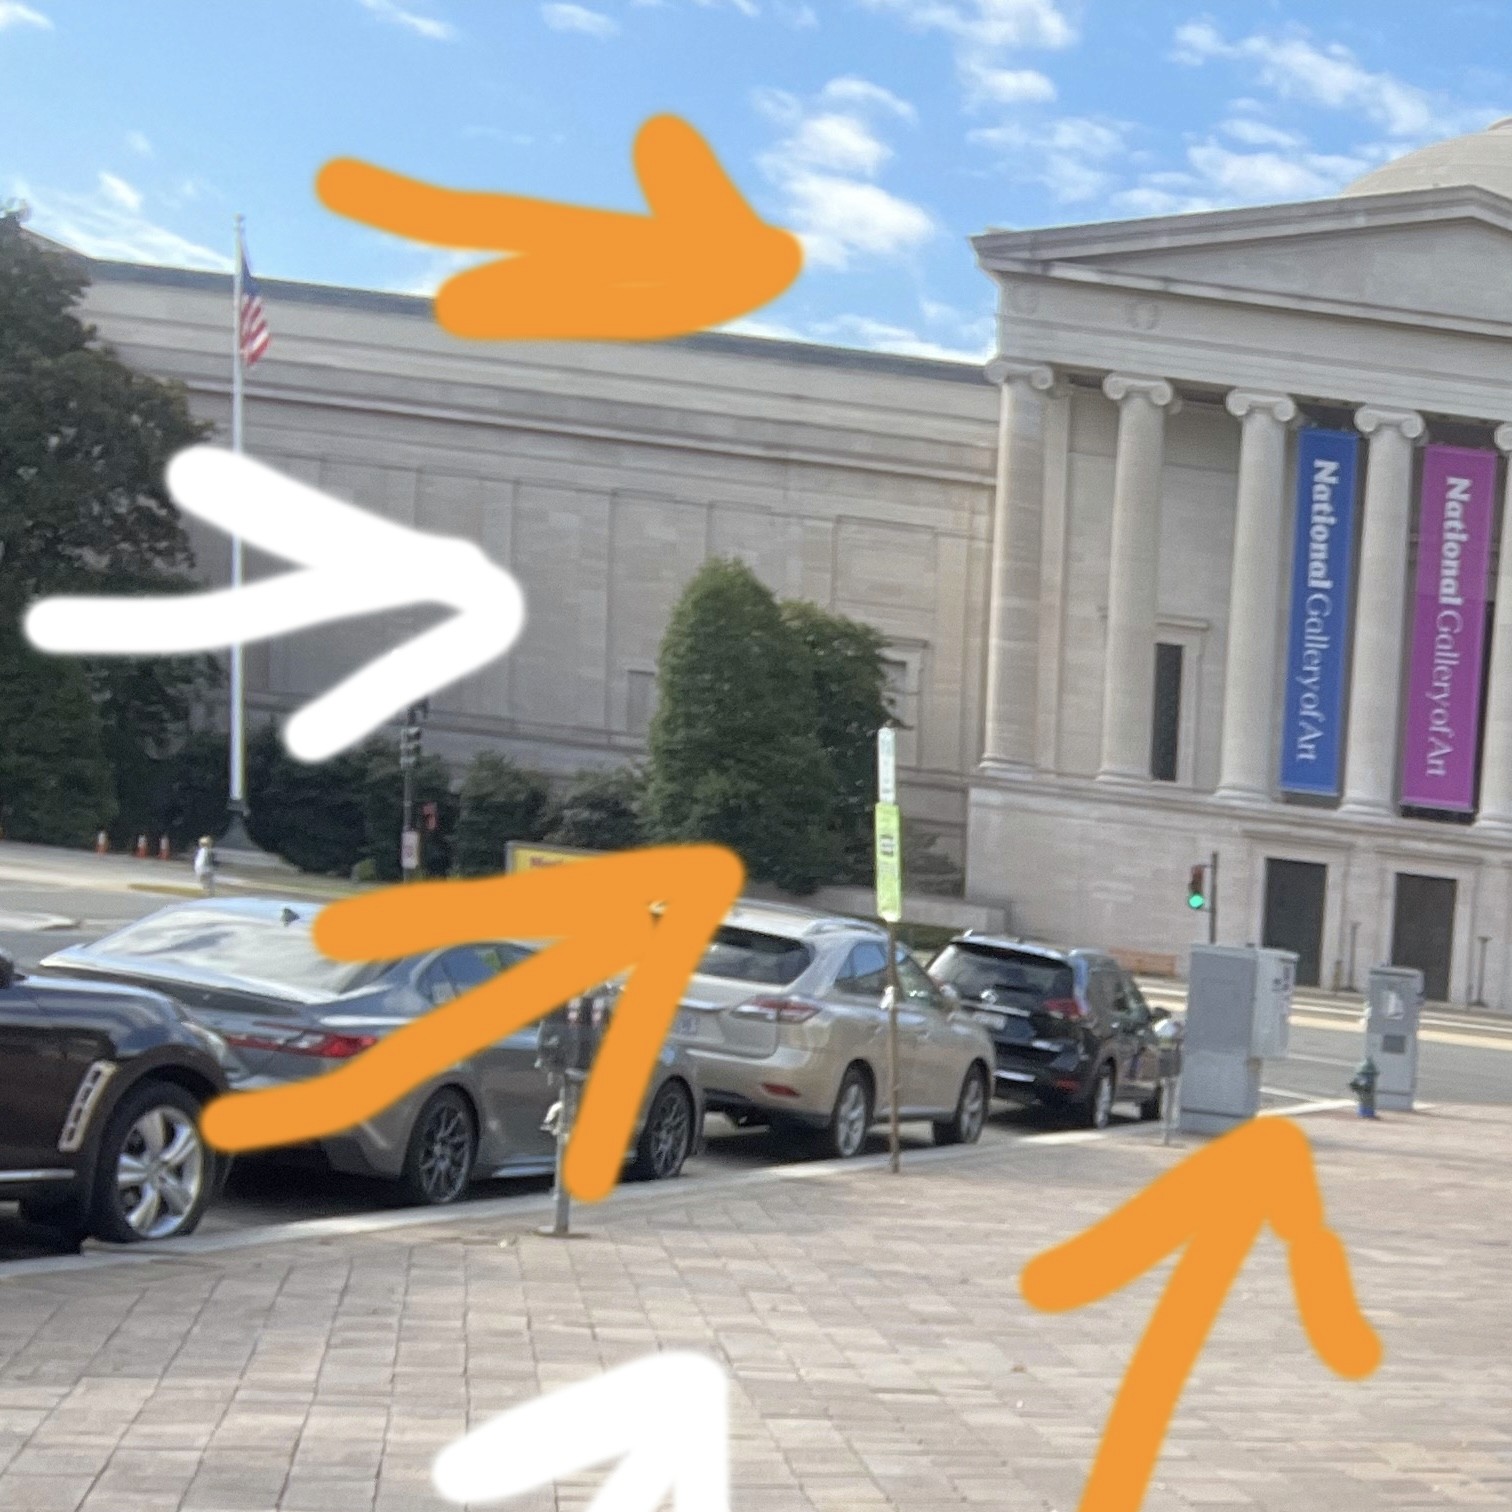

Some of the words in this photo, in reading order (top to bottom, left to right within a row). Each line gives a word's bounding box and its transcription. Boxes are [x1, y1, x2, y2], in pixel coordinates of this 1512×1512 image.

[1307, 458, 1340, 589] National
[1438, 476, 1472, 605] National
[1295, 593, 1333, 691] Gallery
[1425, 610, 1463, 707] Gallery
[1296, 719, 1324, 761] Art
[1300, 692, 1326, 723] of
[1429, 708, 1455, 738] of
[1426, 736, 1453, 776] Art
